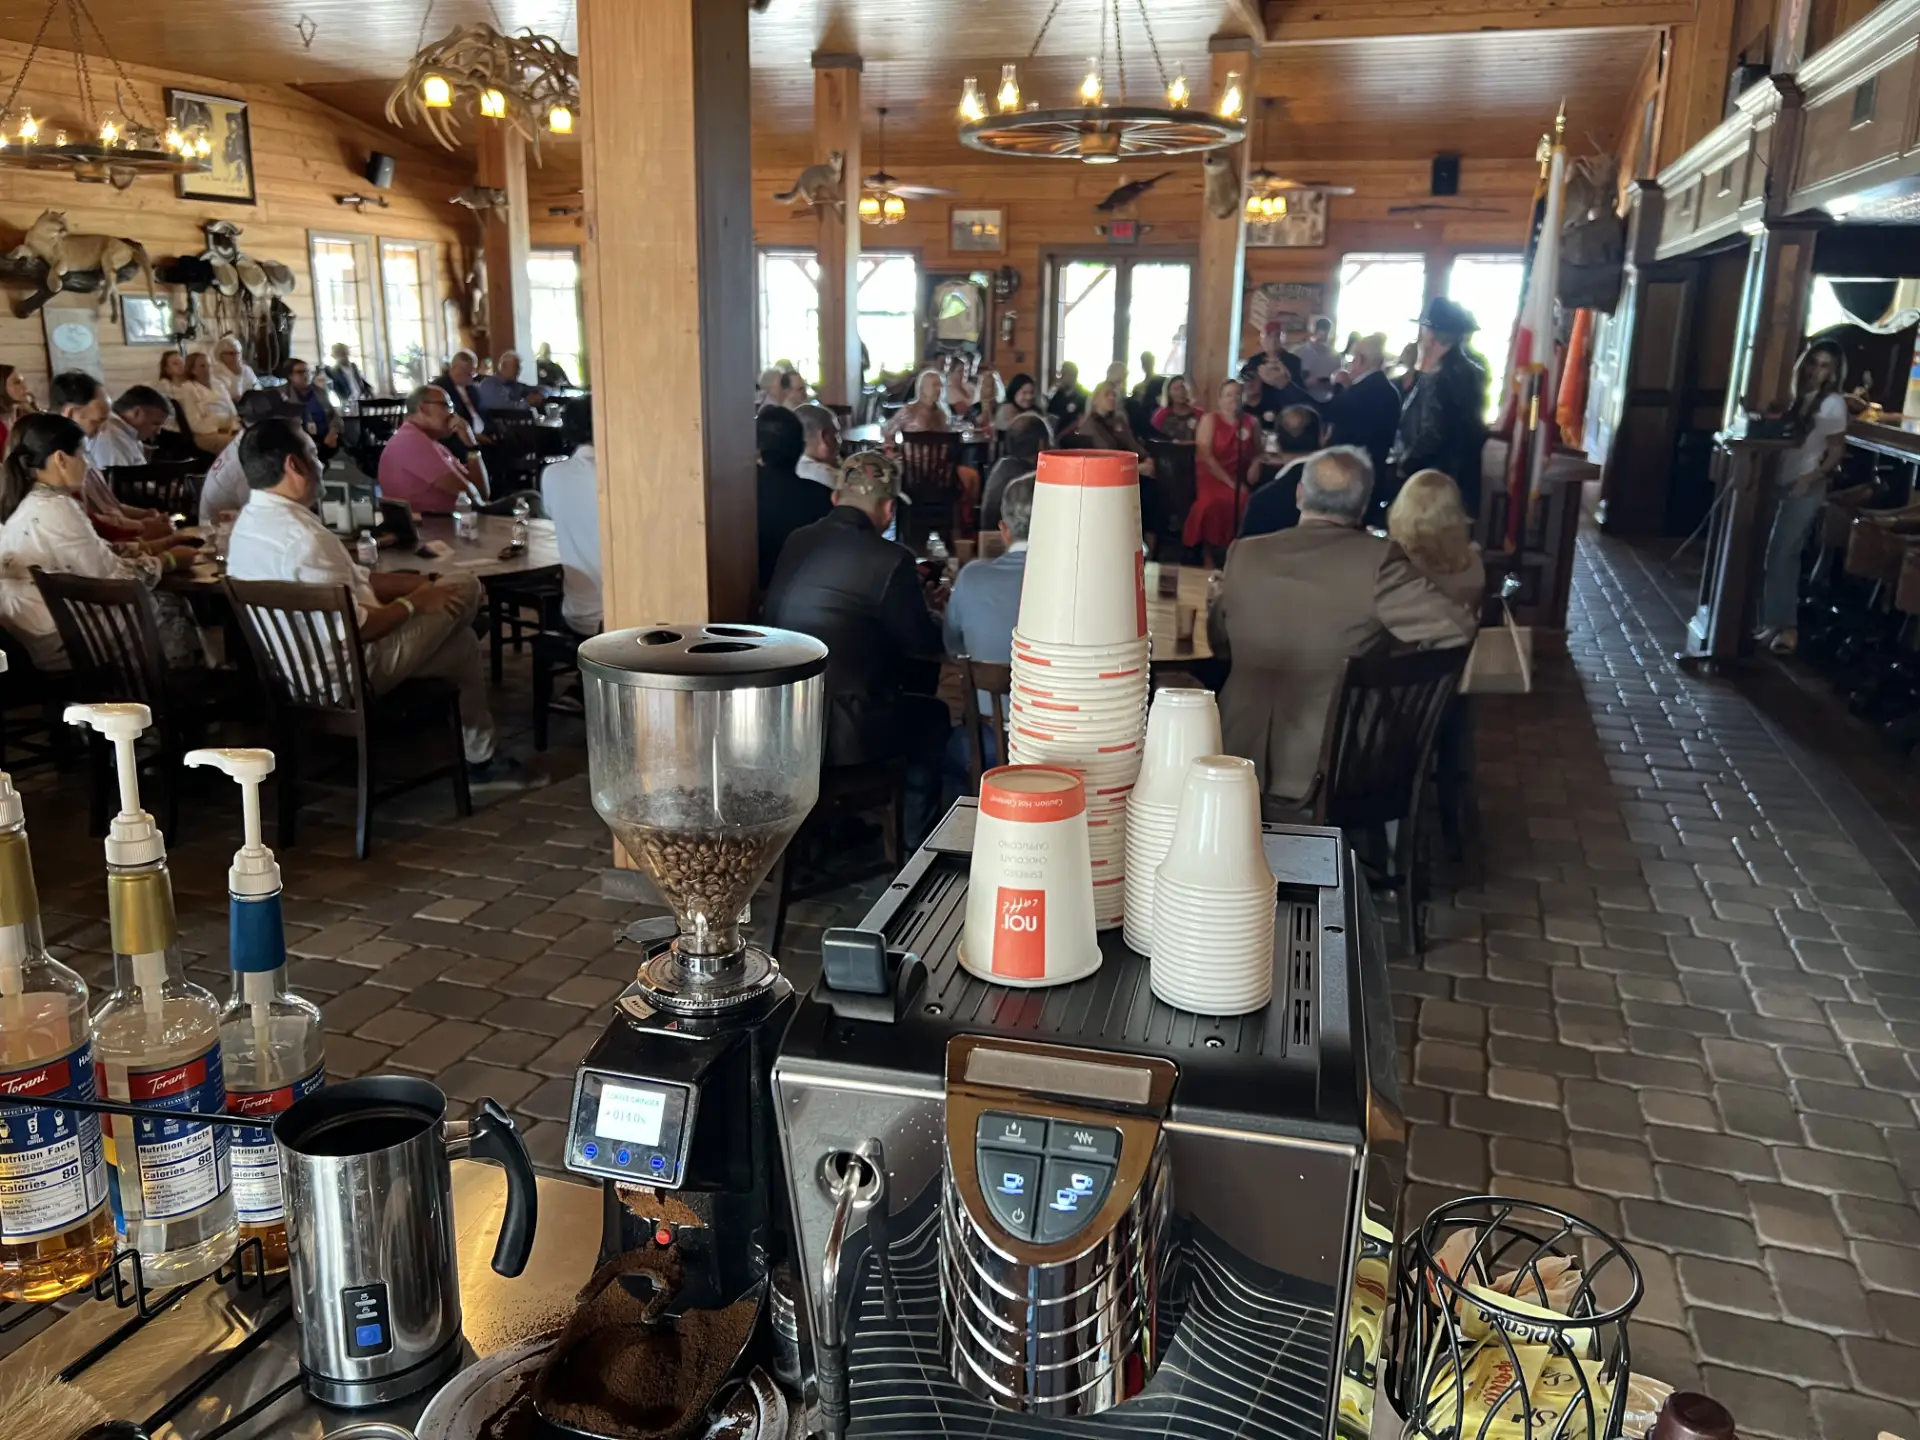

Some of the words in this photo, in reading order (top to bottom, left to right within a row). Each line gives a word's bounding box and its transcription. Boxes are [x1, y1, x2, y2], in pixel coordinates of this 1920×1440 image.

[998, 840, 1049, 851] CAPPUCCINO
[1000, 853, 1048, 865] CHOCOLATE
[1, 1070, 47, 1095] Torani
[147, 1068, 187, 1096] Torani
[237, 1093, 274, 1113] Torani
[0, 1152, 43, 1164] utrition
[48, 1139, 76, 1156] Facts
[139, 1141, 183, 1154] Nutrition
[186, 1130, 210, 1145] Facts
[232, 1147, 265, 1155] utrition
[143, 1167, 186, 1180] Calories
[198, 1152, 212, 1166] 80
[232, 1170, 266, 1178] alories
[0, 1180, 48, 1193] Calories
[62, 1165, 79, 1180] 80
